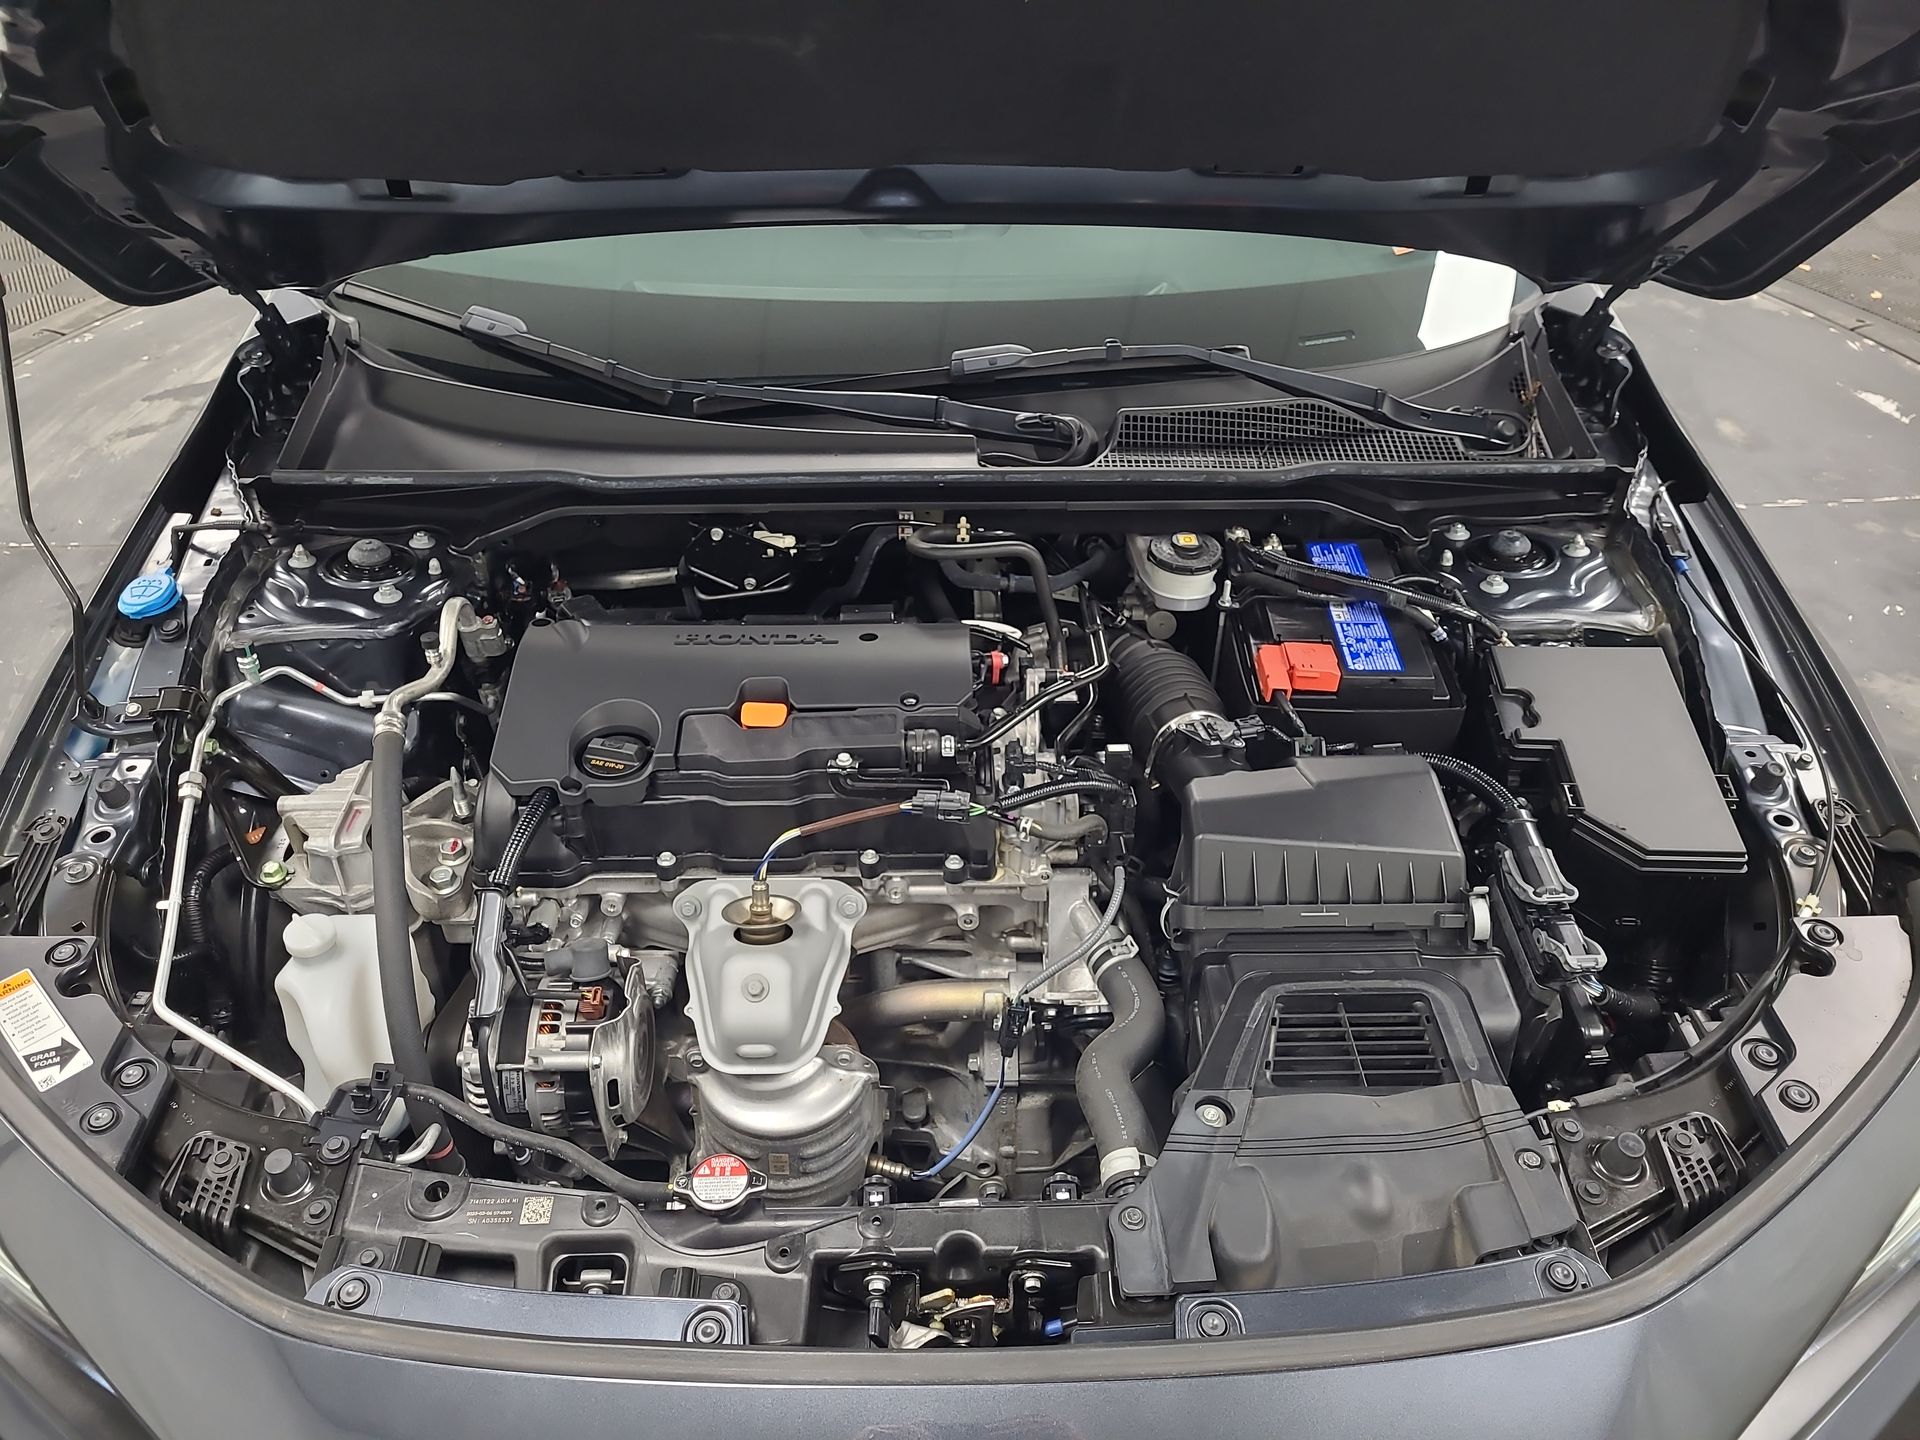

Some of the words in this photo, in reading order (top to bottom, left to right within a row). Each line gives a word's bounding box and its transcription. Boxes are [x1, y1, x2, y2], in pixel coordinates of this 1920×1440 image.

[673, 633, 839, 646] HONDA
[0, 979, 31, 997] ARNING
[29, 1051, 56, 1062] GRAB
[33, 1056, 61, 1069] FOAM
